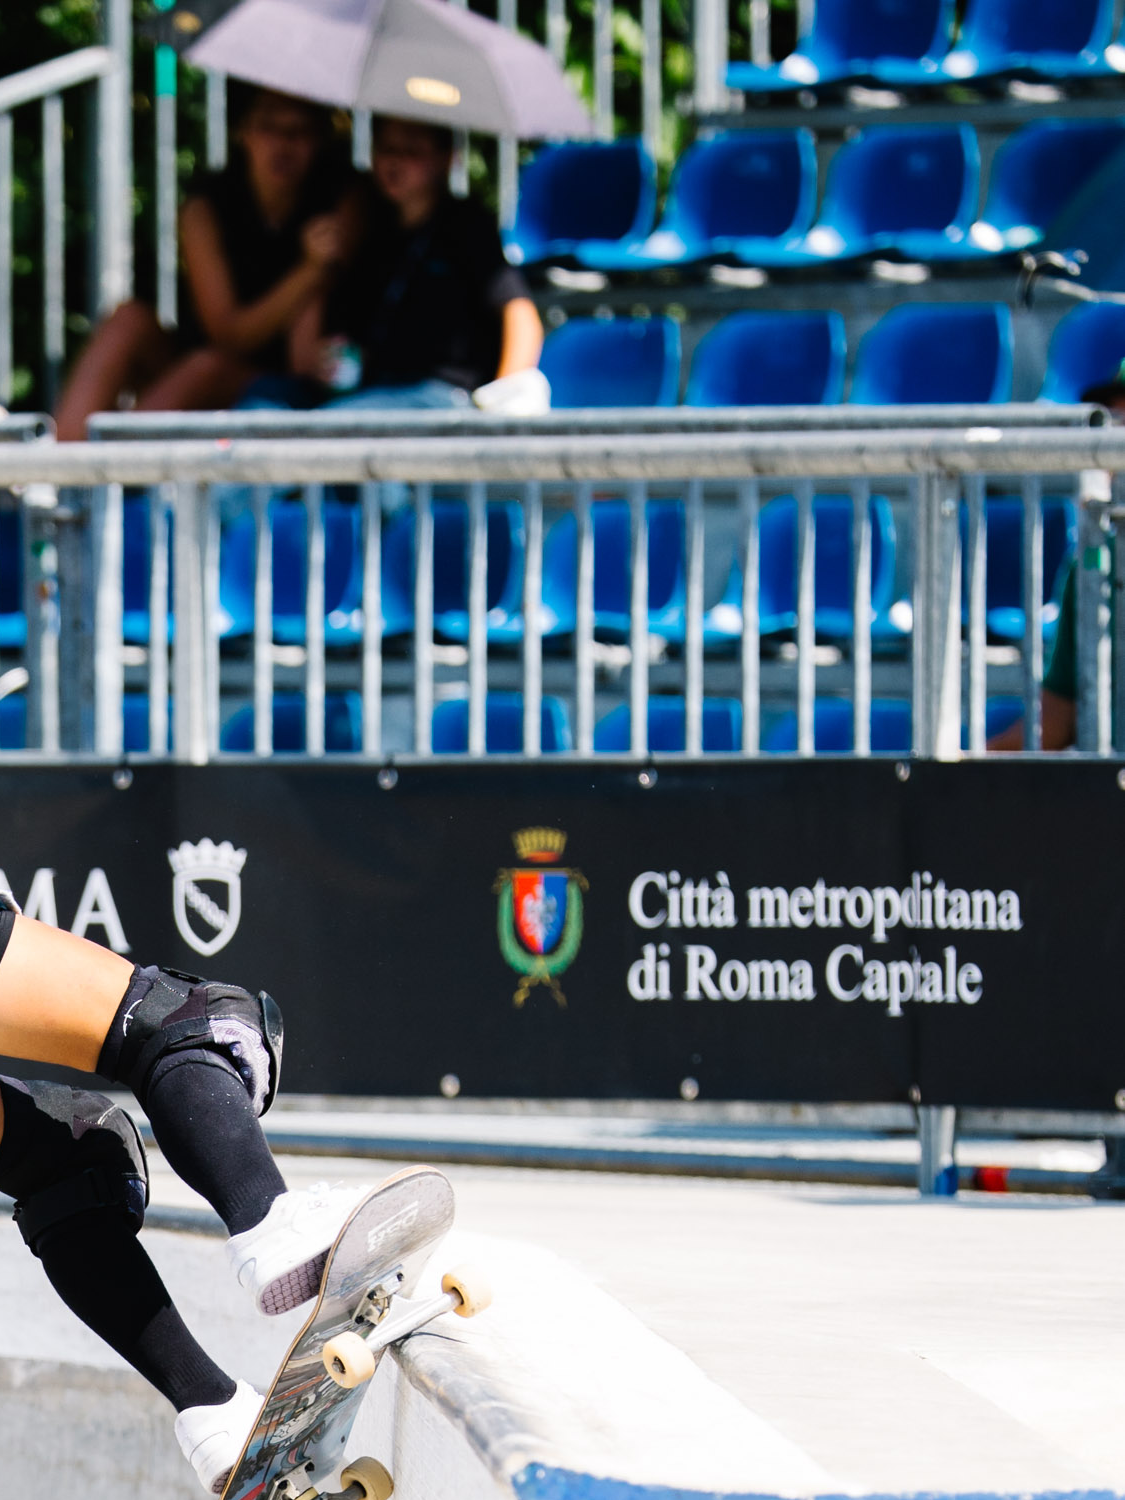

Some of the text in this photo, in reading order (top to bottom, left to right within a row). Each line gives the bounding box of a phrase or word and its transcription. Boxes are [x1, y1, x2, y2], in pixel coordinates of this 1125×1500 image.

[629, 871, 737, 929] Città
[627, 943, 671, 1001] di
[684, 944, 816, 1001] Roma
